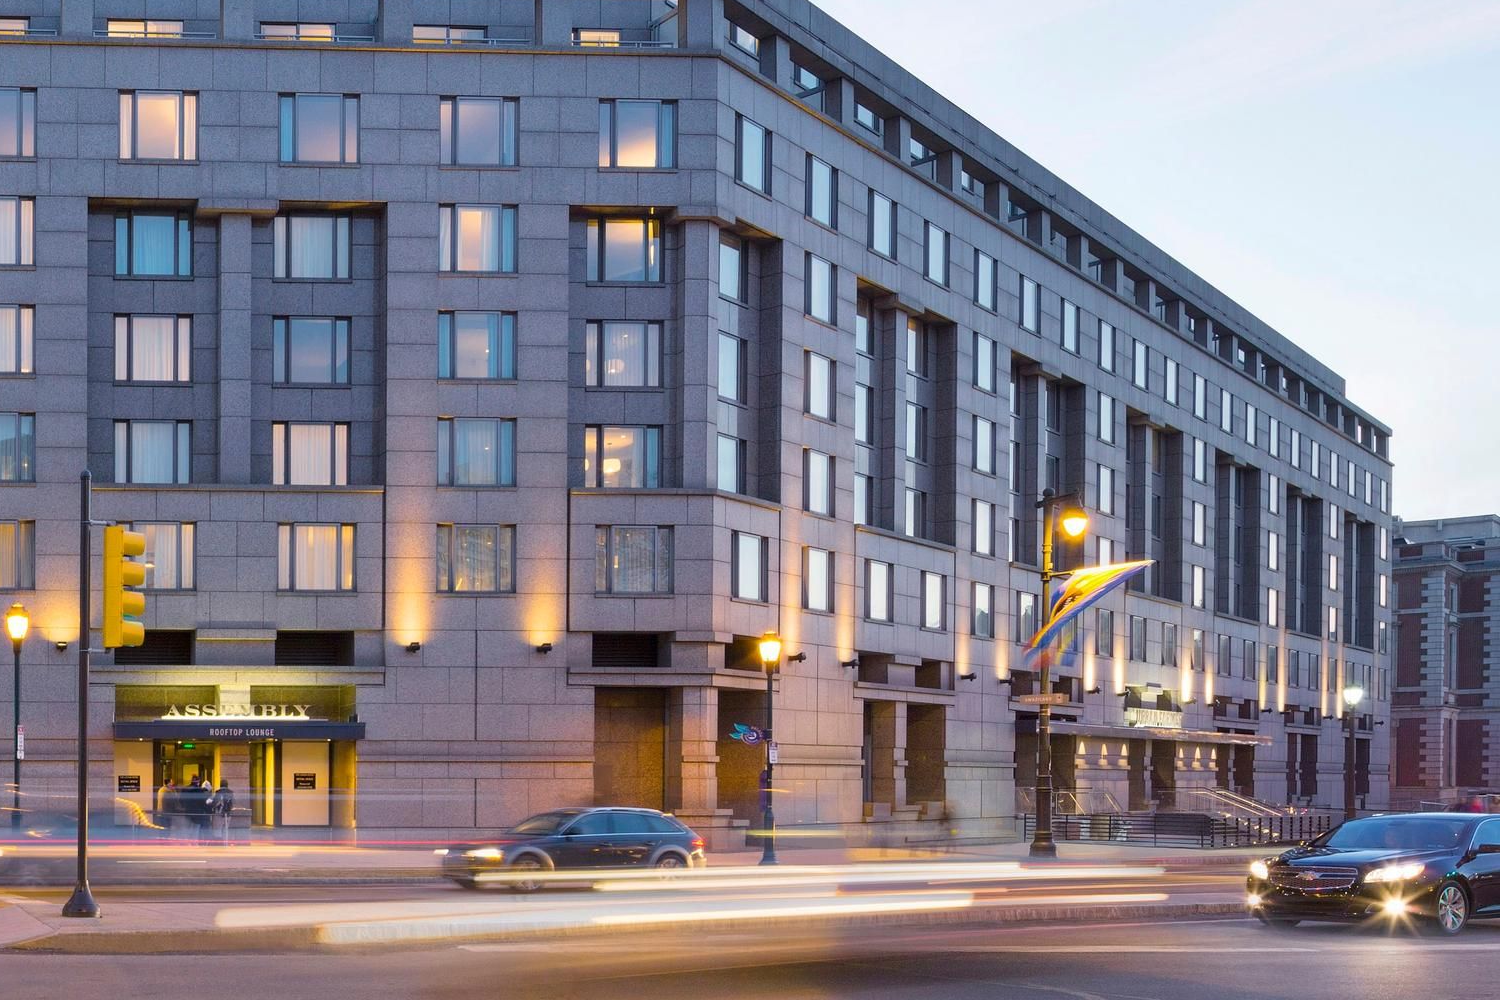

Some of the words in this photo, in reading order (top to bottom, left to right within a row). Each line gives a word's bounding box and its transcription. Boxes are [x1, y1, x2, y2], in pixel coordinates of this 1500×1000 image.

[165, 704, 311, 718] ASSEMBLY
[209, 728, 243, 737] ROOFTOP
[245, 728, 275, 737] LOUNGE
